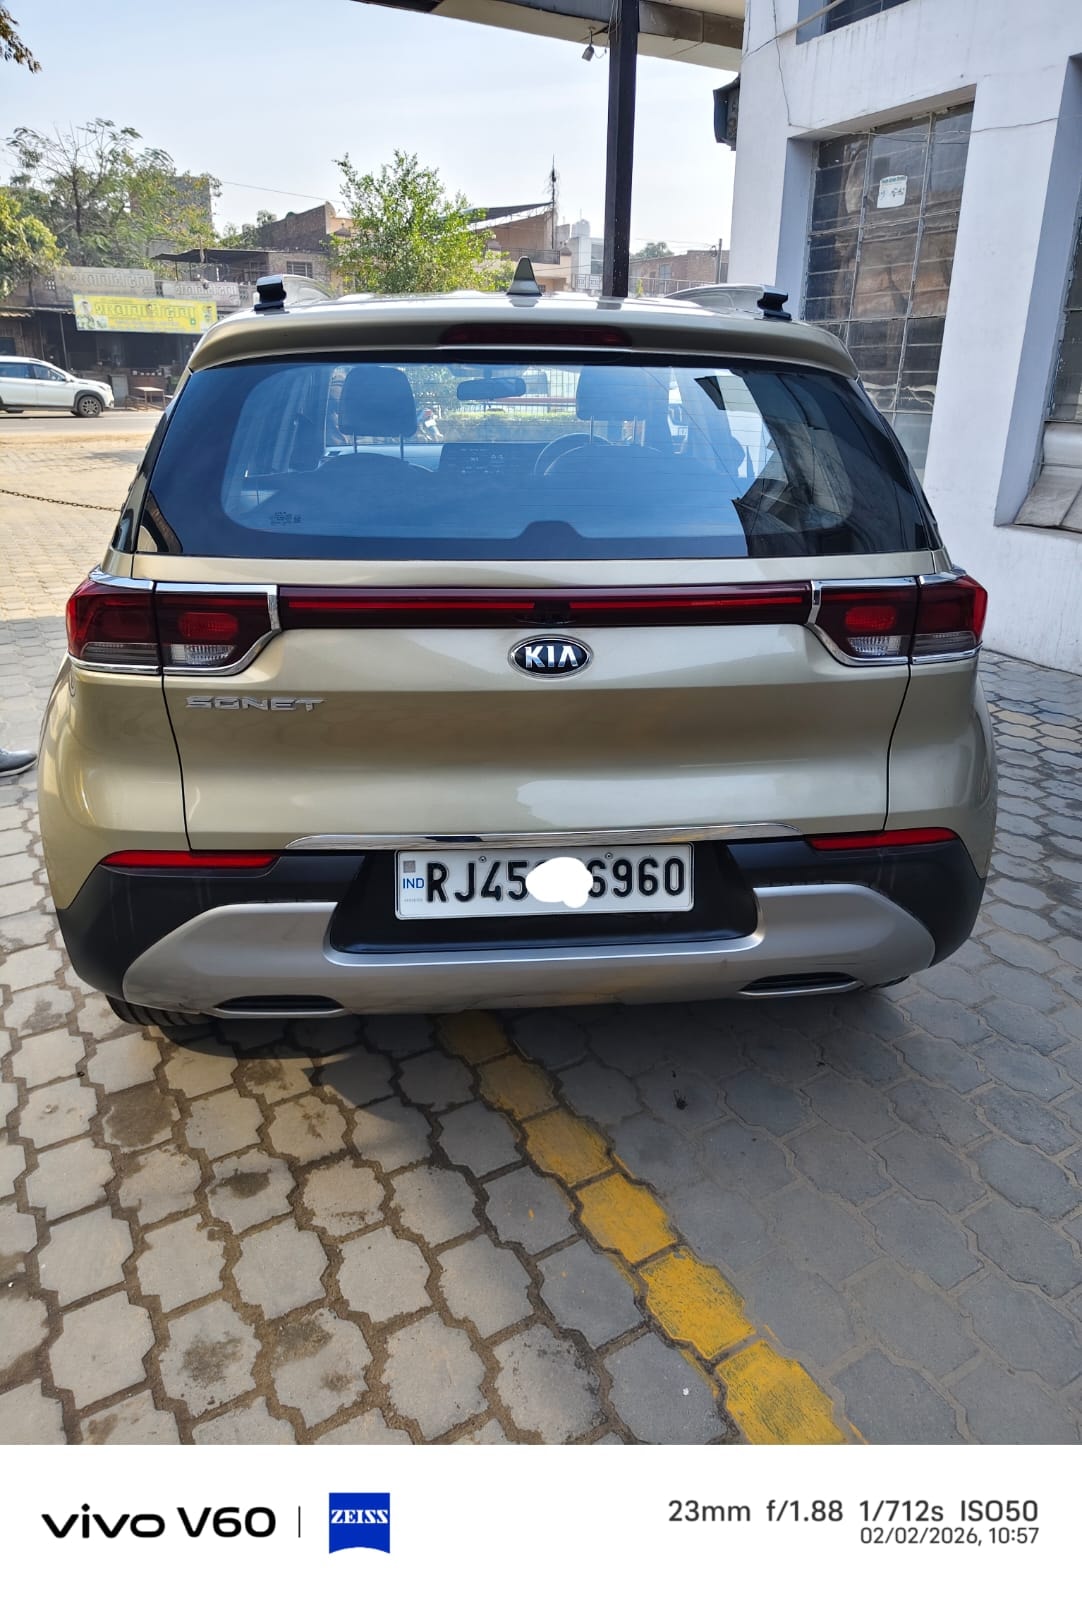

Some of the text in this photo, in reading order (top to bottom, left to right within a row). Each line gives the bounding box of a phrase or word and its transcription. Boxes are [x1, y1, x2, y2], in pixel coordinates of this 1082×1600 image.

[524, 645, 579, 668] KIA
[183, 695, 325, 712] SONET
[402, 877, 425, 889] IND
[426, 857, 685, 903] RJ456960
